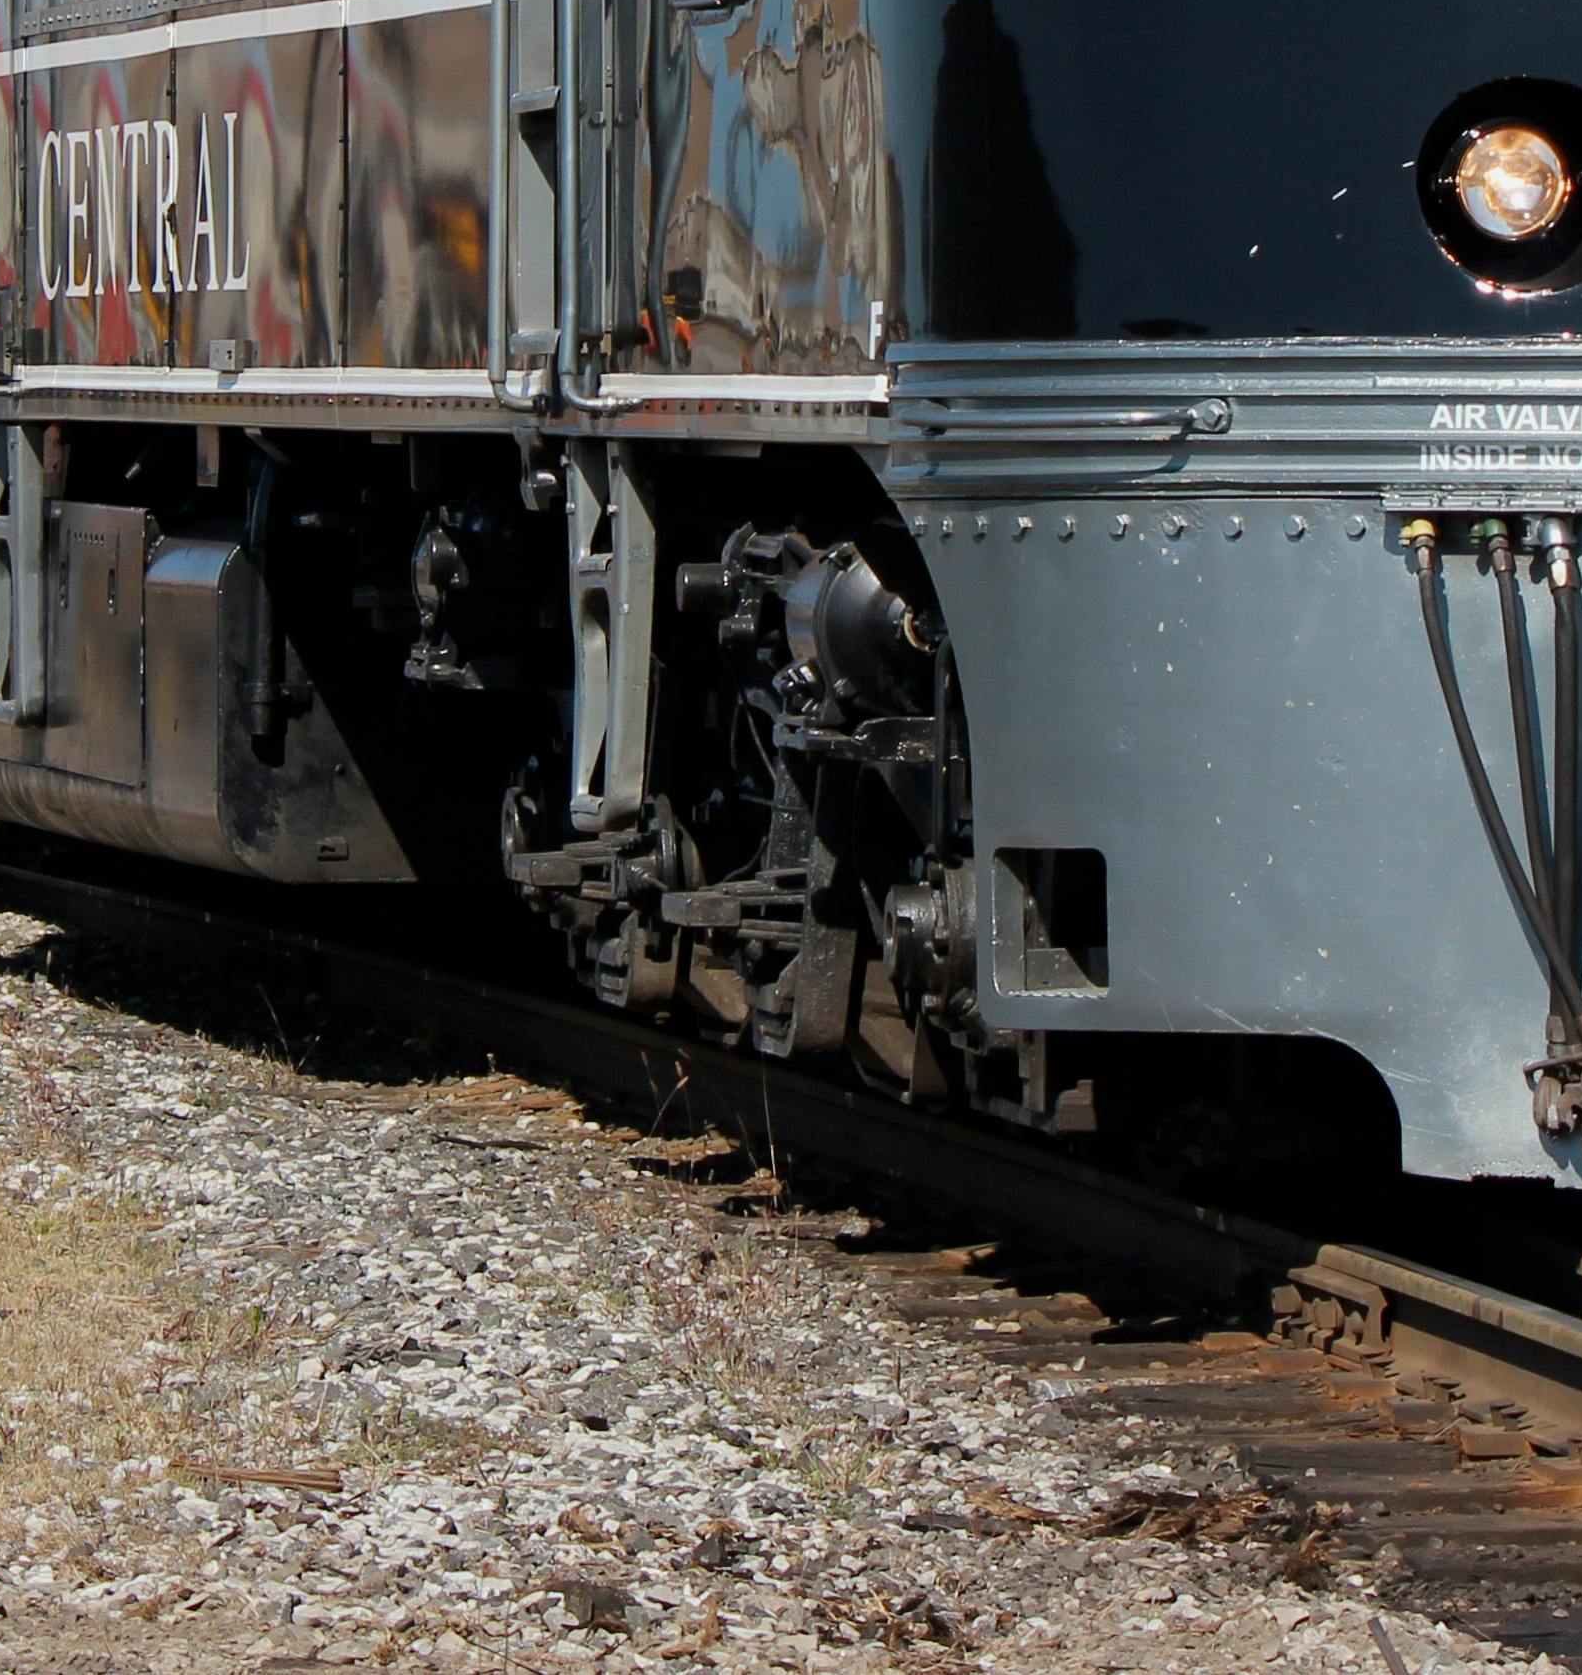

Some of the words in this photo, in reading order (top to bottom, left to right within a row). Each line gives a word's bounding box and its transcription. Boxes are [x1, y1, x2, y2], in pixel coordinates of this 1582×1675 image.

[37, 111, 250, 301] CENTRAL
[869, 300, 884, 360] F
[1429, 403, 1488, 429] AIR
[1420, 444, 1527, 470] INSIDE
